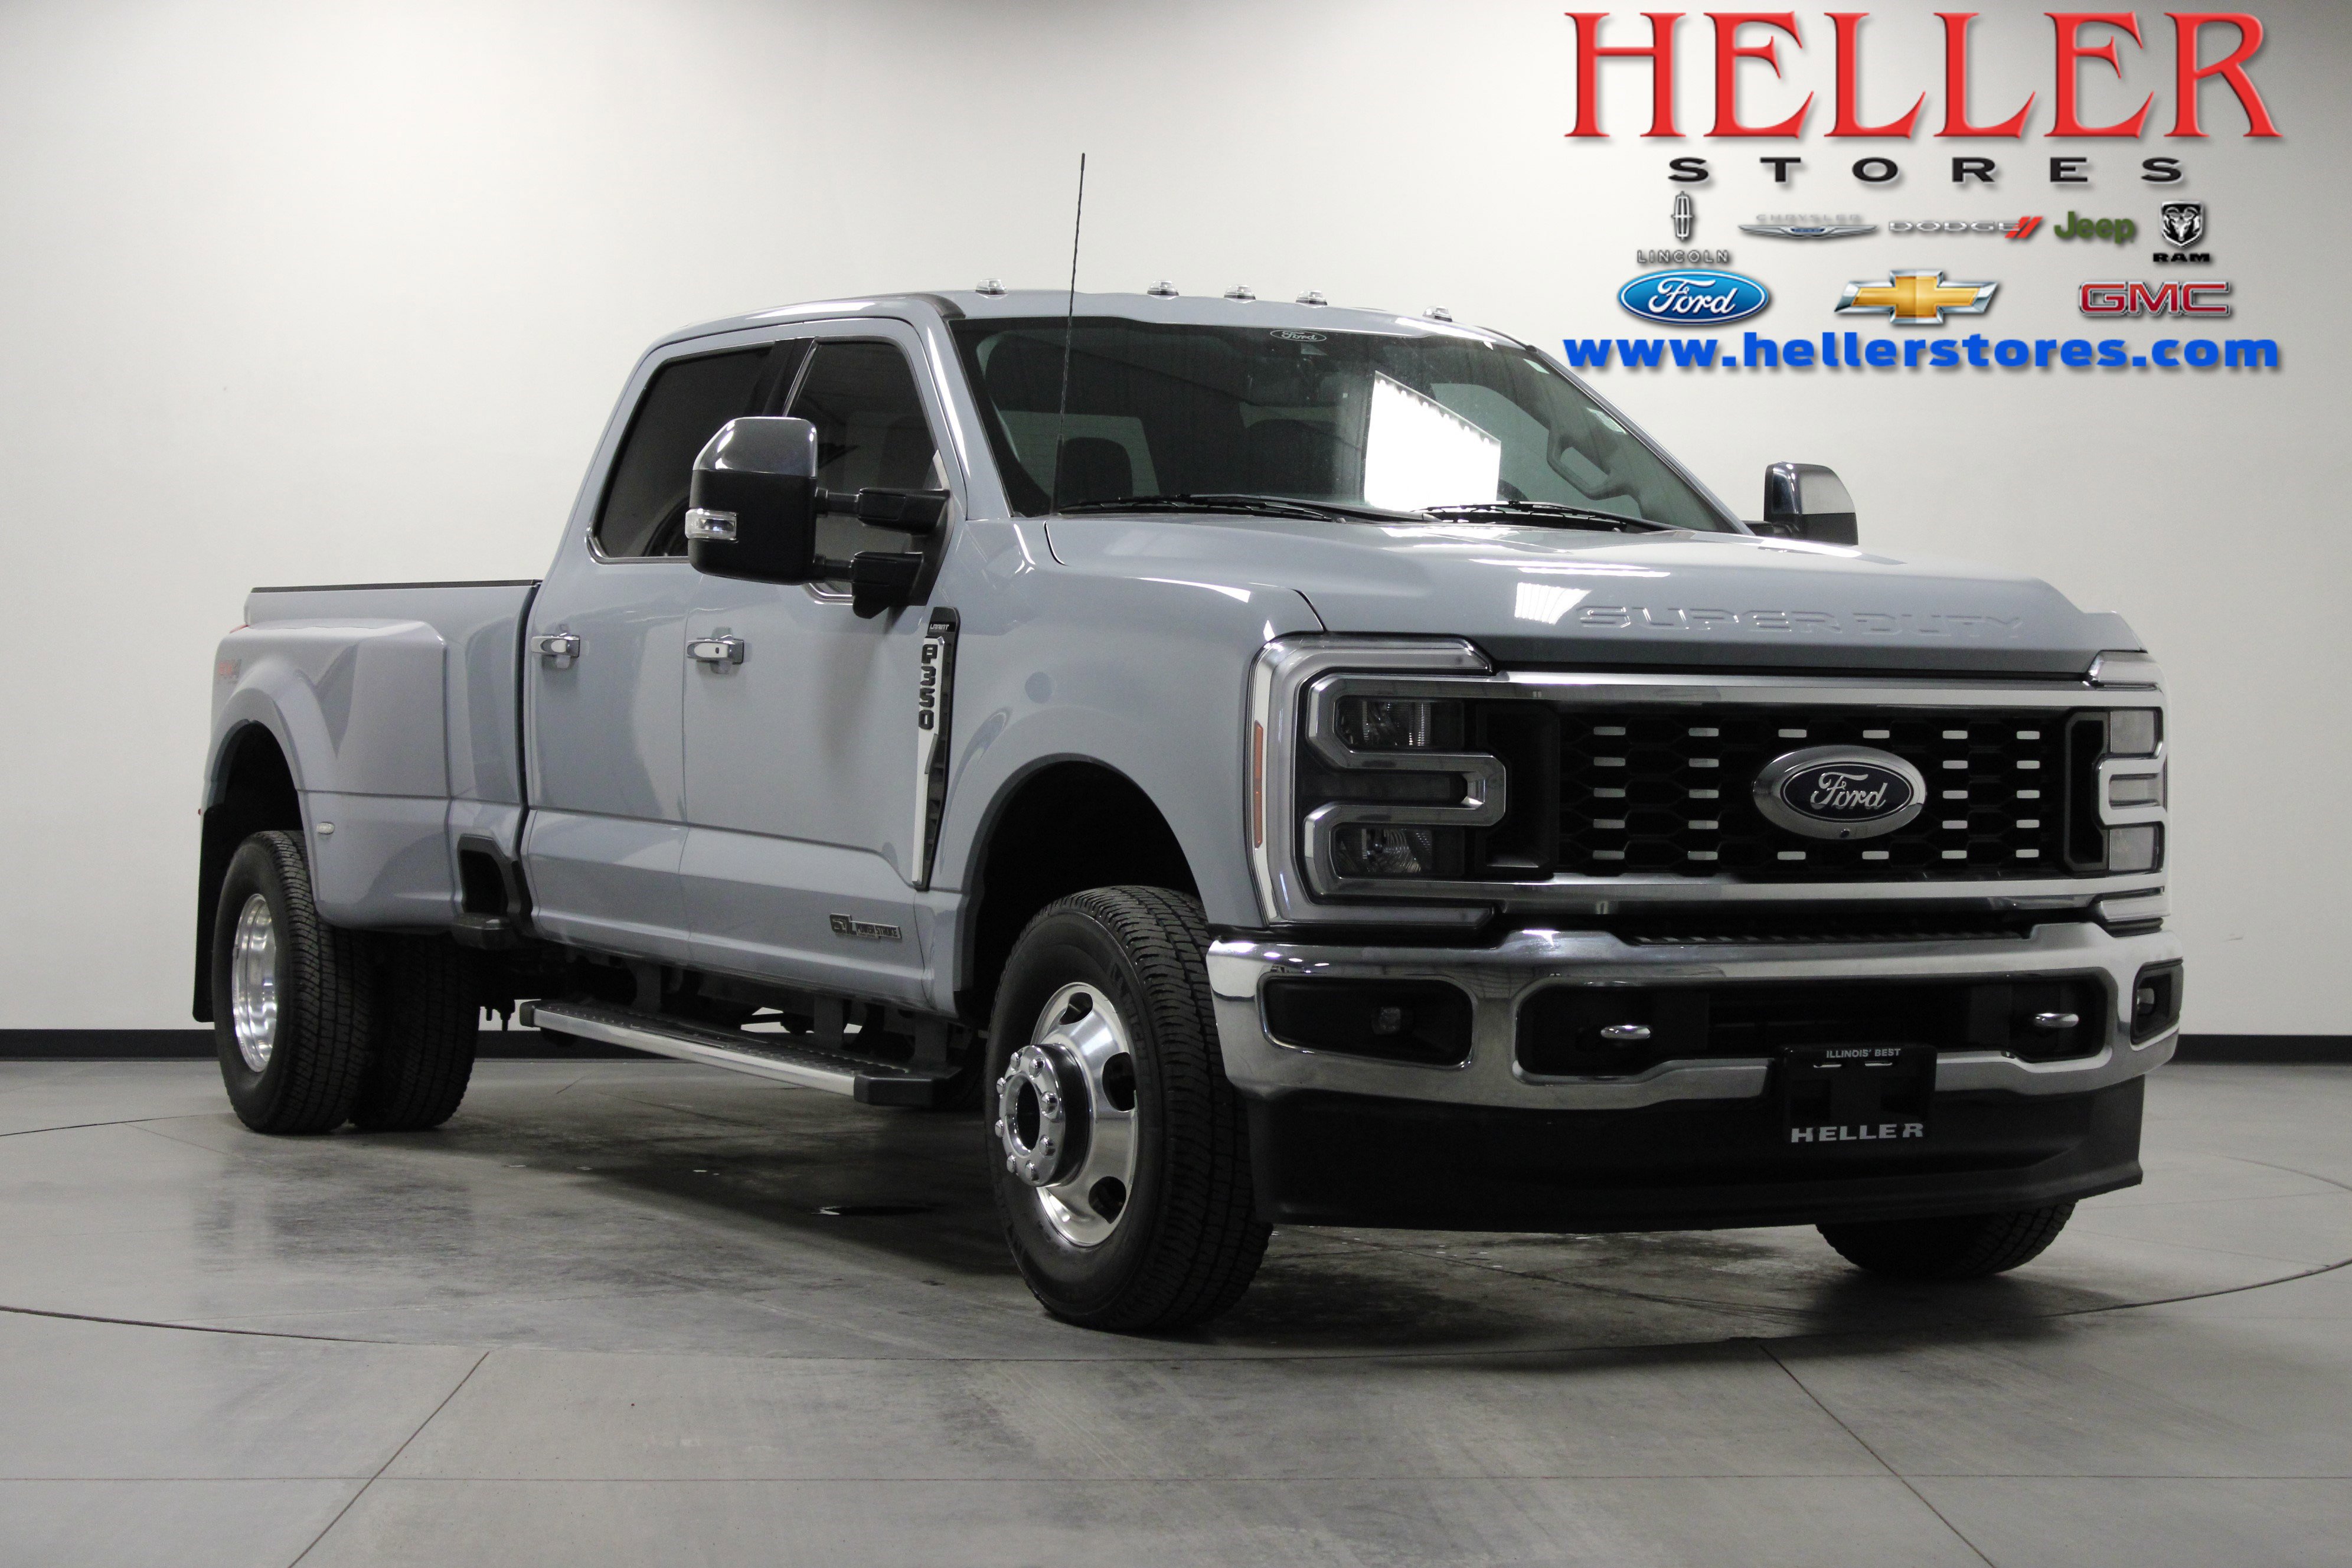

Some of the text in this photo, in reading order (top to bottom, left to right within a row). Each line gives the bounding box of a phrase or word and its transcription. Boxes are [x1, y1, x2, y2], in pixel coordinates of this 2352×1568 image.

[1280, 331, 1317, 340] Ford
[1575, 605, 2024, 638] SUPER DUTY
[1809, 771, 1888, 809] Ford
[1826, 1048, 1901, 1059] ILLINOIS' BEST
[1791, 1123, 1923, 1143] HELLER
